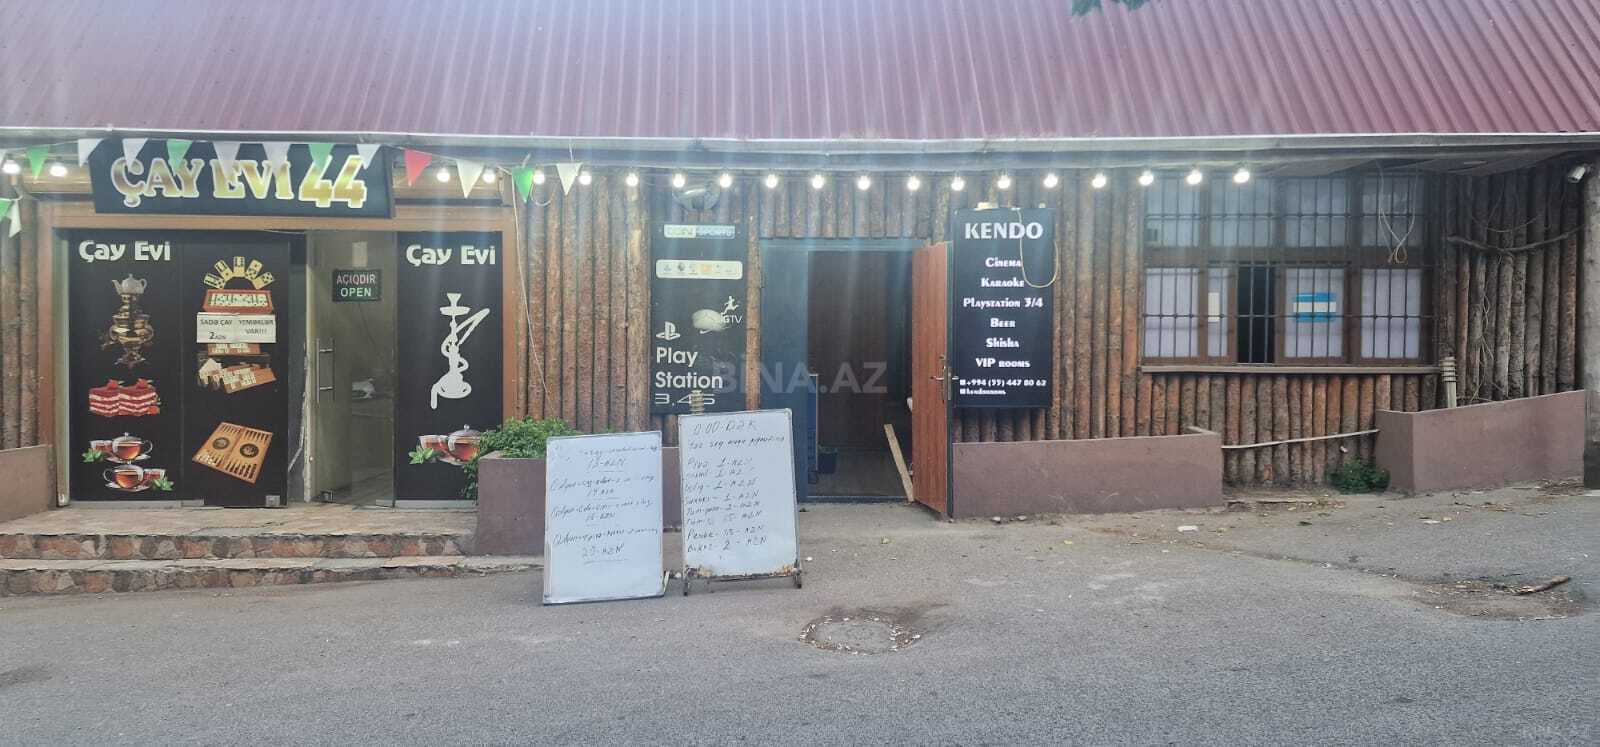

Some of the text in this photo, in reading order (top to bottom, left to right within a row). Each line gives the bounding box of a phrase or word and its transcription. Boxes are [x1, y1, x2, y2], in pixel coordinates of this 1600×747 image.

[111, 157, 204, 207] ÇAY
[299, 154, 367, 208] 44
[964, 222, 1044, 240] KENDO
[79, 241, 171, 263] Çay Evi
[406, 245, 497, 266] Çay Evi
[340, 287, 372, 297] OPEN
[656, 346, 698, 367] Play
[975, 358, 996, 368] VIP
[655, 371, 723, 389] Station
